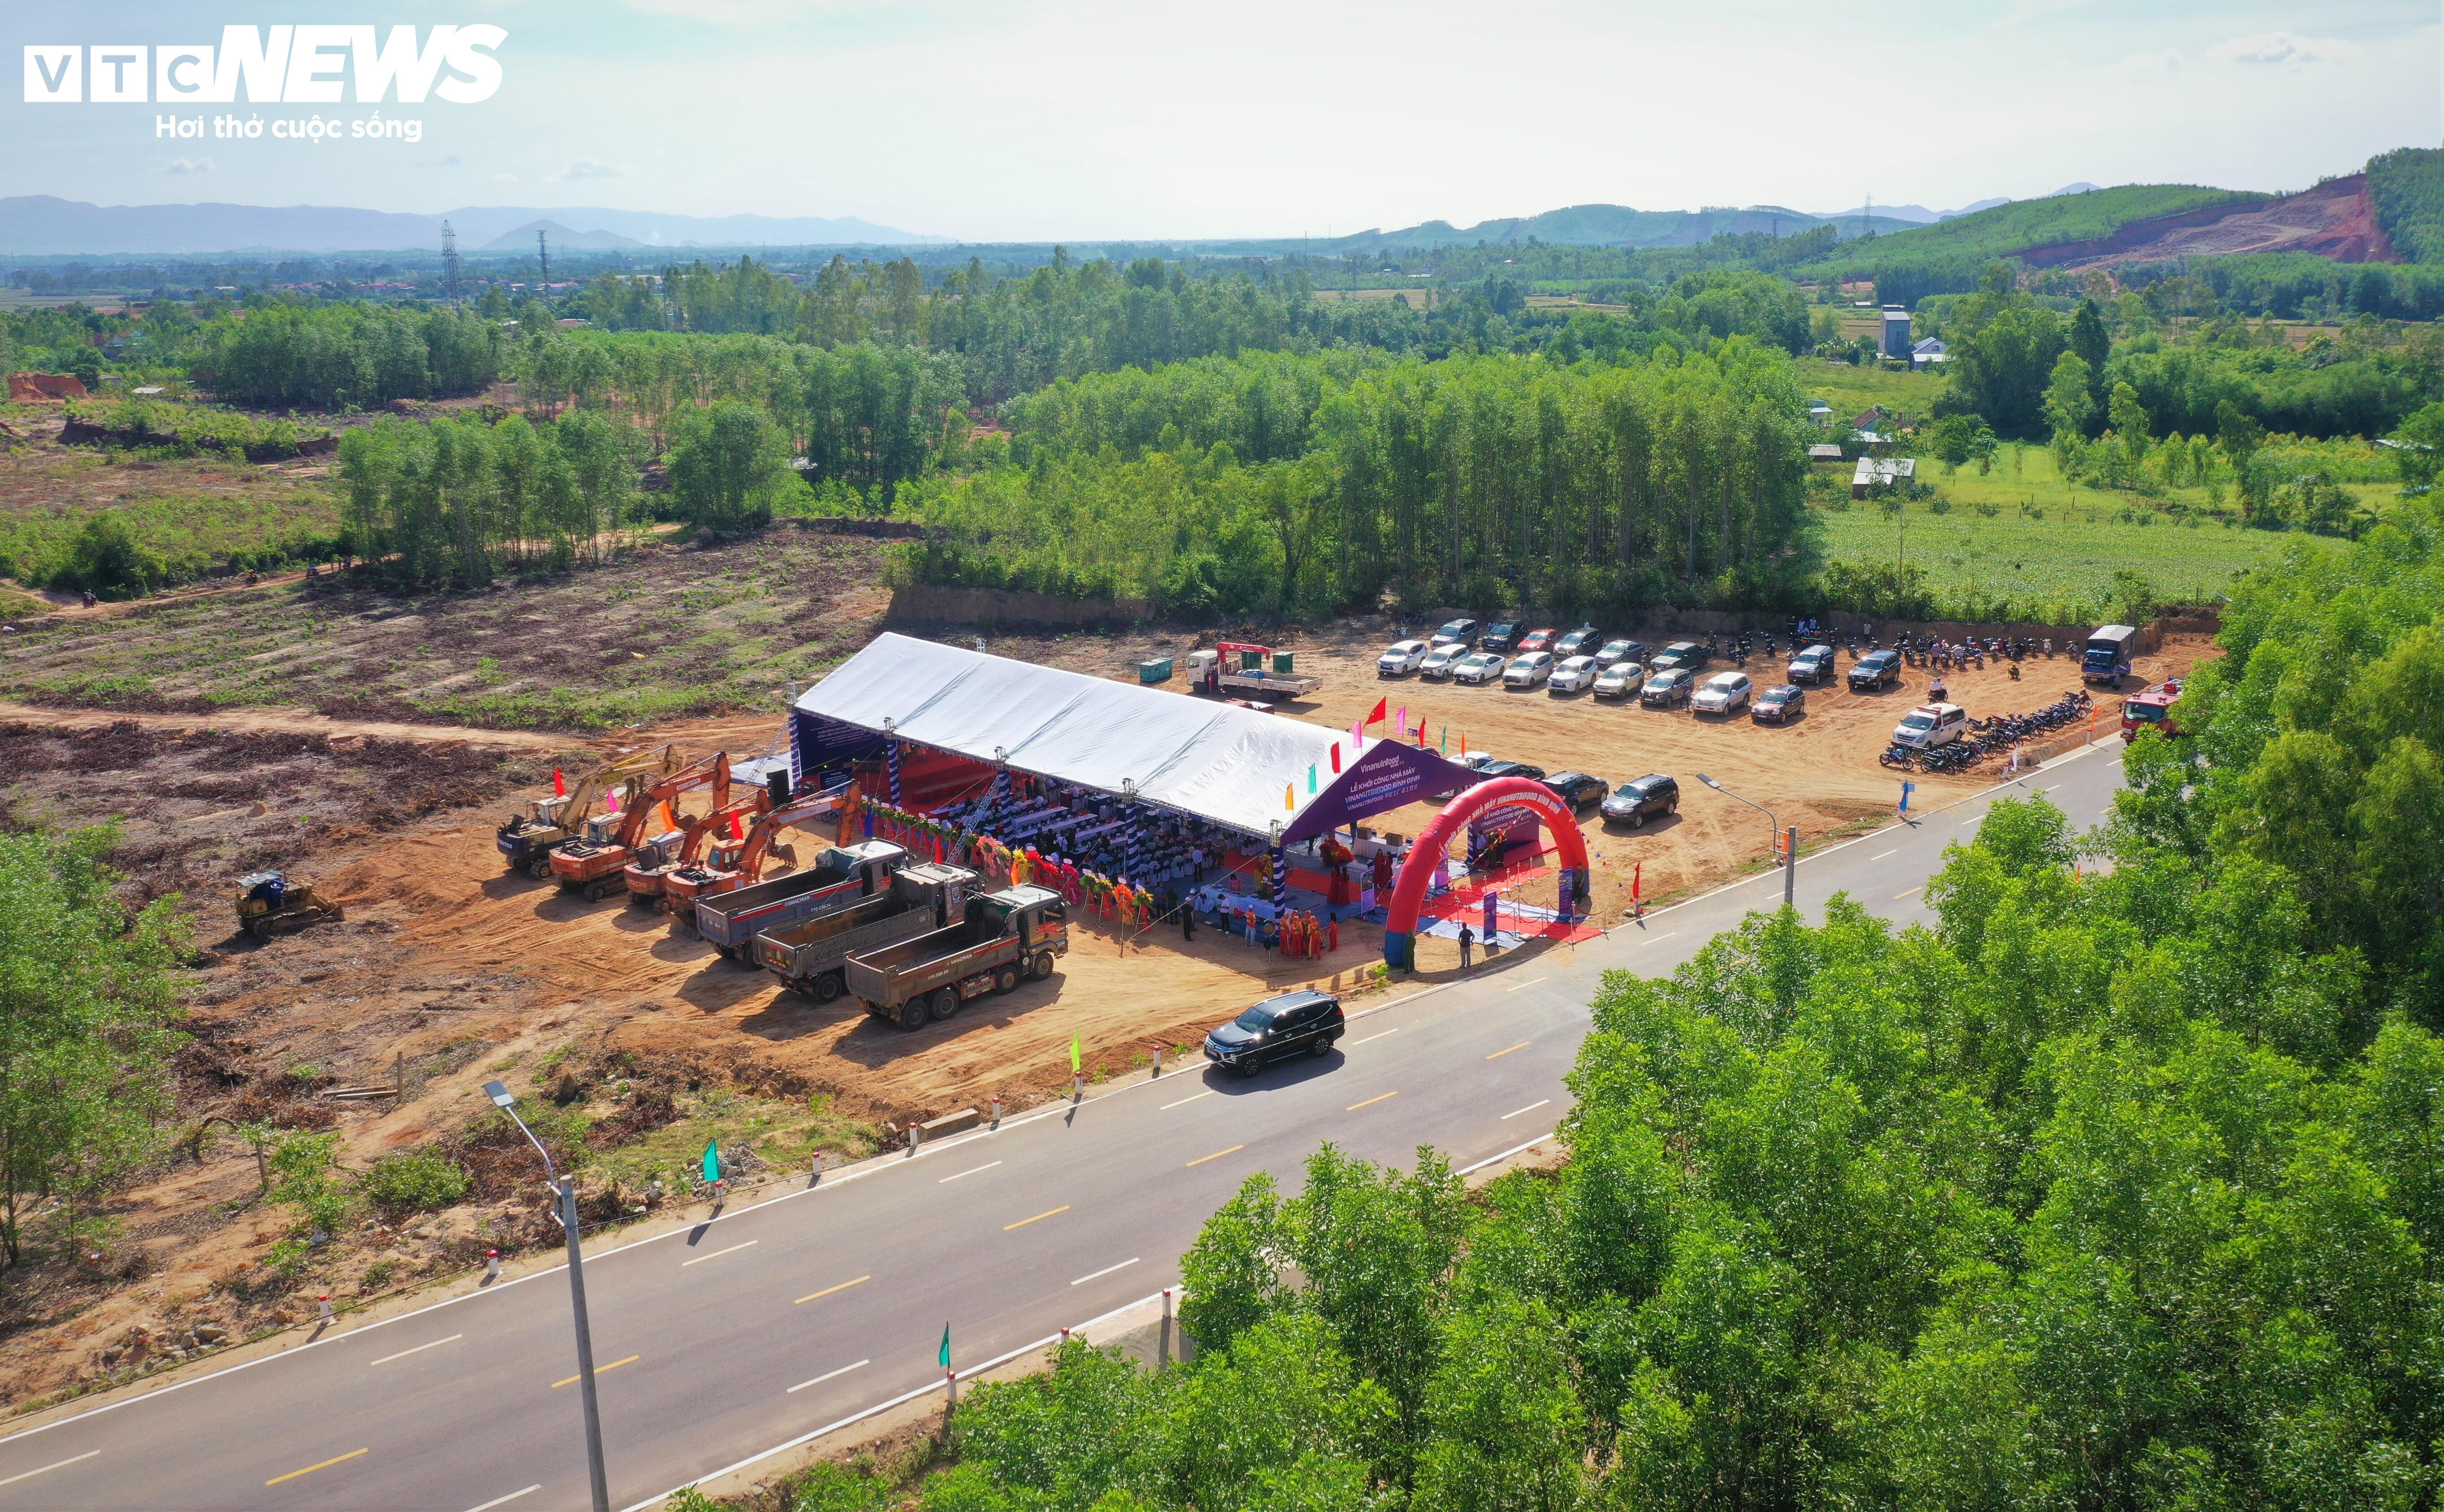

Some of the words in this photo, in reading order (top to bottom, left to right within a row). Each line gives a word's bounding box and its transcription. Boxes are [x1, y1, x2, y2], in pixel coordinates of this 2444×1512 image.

[1361, 755, 1399, 773] Vinanutrifood
[1350, 782, 1358, 793] LỄ
[1358, 779, 1373, 790] KHỞI
[1374, 776, 1389, 785] CÔNG
[1390, 769, 1402, 780] NHÀ
[1403, 767, 1415, 777] MÁY
[1345, 784, 1392, 803] VINANUTRIFOOD
[1393, 779, 1406, 788] BÌNH
[1407, 774, 1420, 784] ĐỊNH
[1347, 795, 1384, 811] VINANUTRIFOOD
[1457, 816, 1471, 834] CÔNG
[1472, 804, 1483, 819] NHÀ
[1484, 798, 1496, 811] MÁY
[1497, 792, 1538, 805] VINANUTRIFOOD
[1537, 793, 1550, 806] BÌNH
[1548, 801, 1561, 815] ĐỊNH
[1480, 812, 1514, 827] VINANUTRIFOOD
[787, 895, 810, 905] SHACMAN
[950, 953, 973, 965] SHACMAN
[965, 981, 991, 994] SHACMAN
